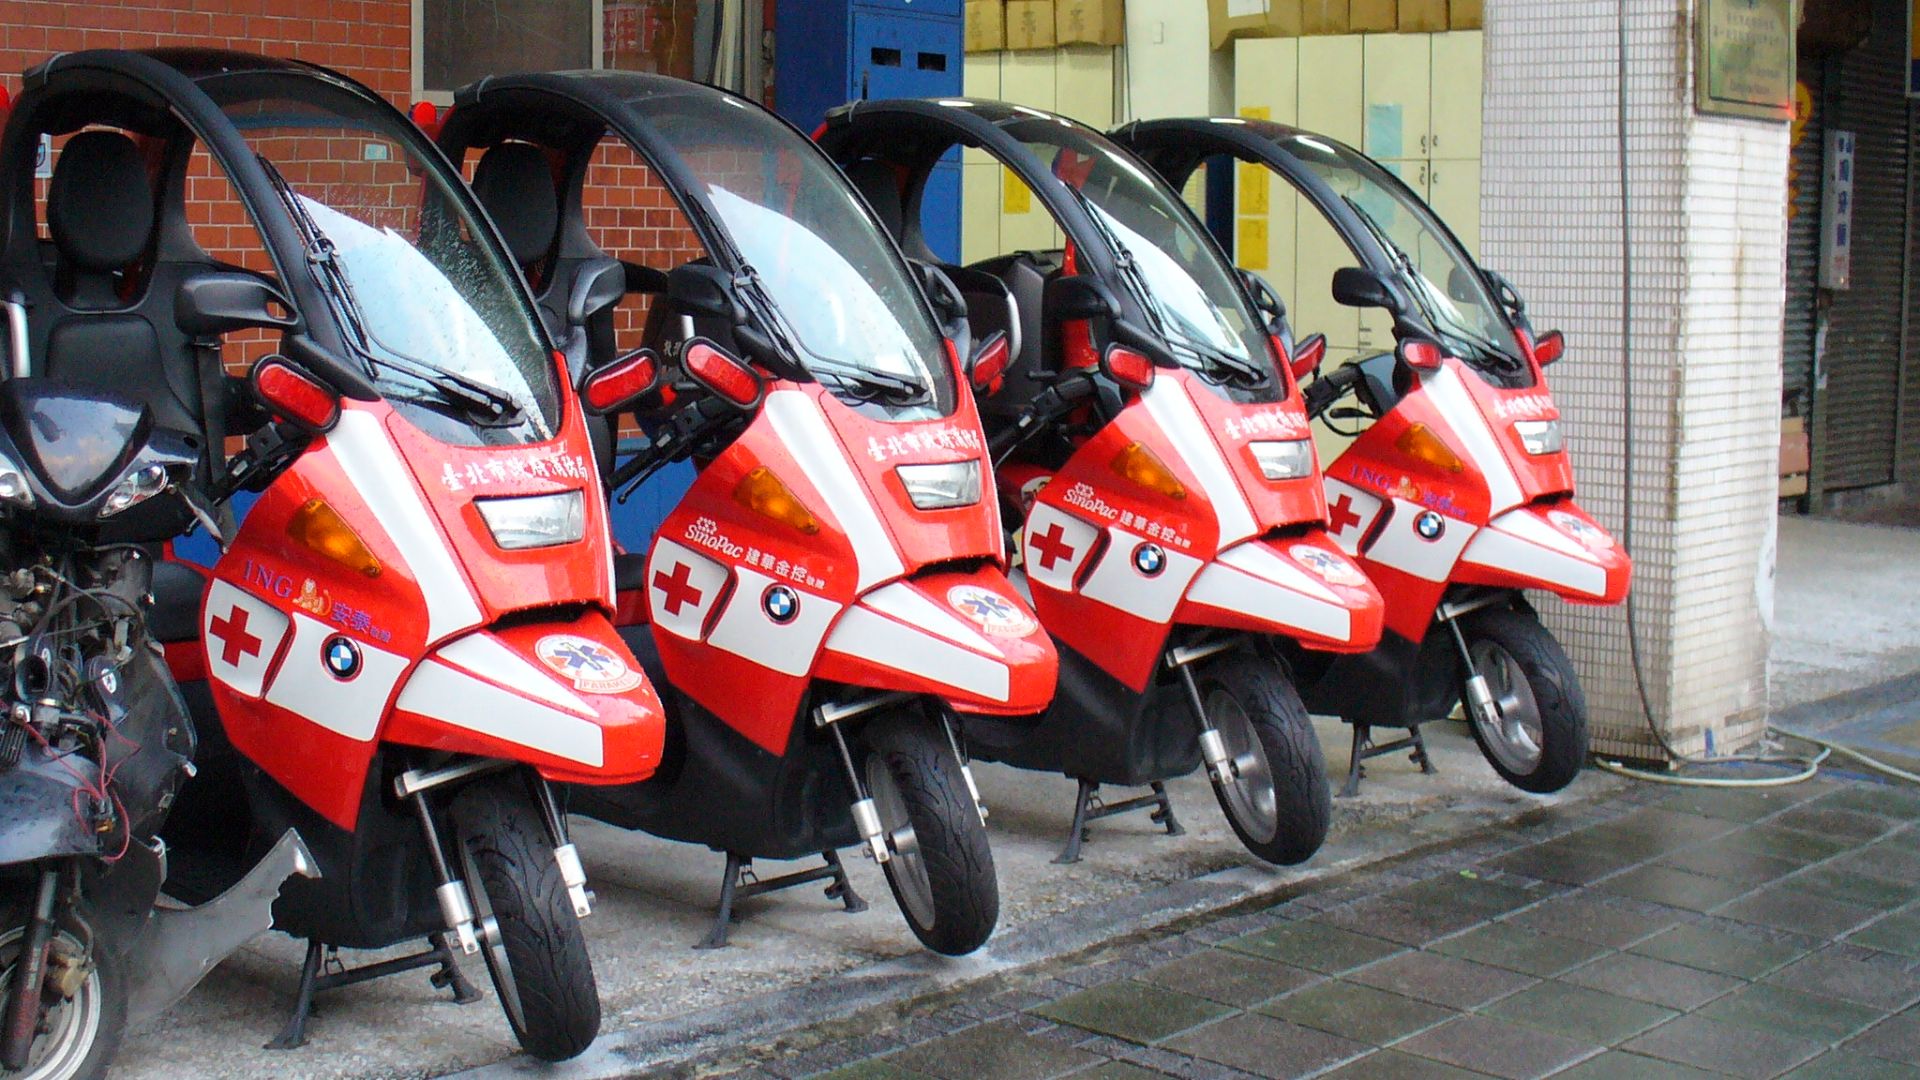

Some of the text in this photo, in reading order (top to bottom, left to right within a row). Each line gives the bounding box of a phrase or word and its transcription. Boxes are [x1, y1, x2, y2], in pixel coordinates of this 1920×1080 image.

[441, 456, 588, 491] 臺北市政府消防局
[1350, 464, 1392, 489] ING
[1063, 489, 1119, 520] SinoPac
[684, 524, 744, 558] SinoPac
[243, 560, 293, 598] ING
